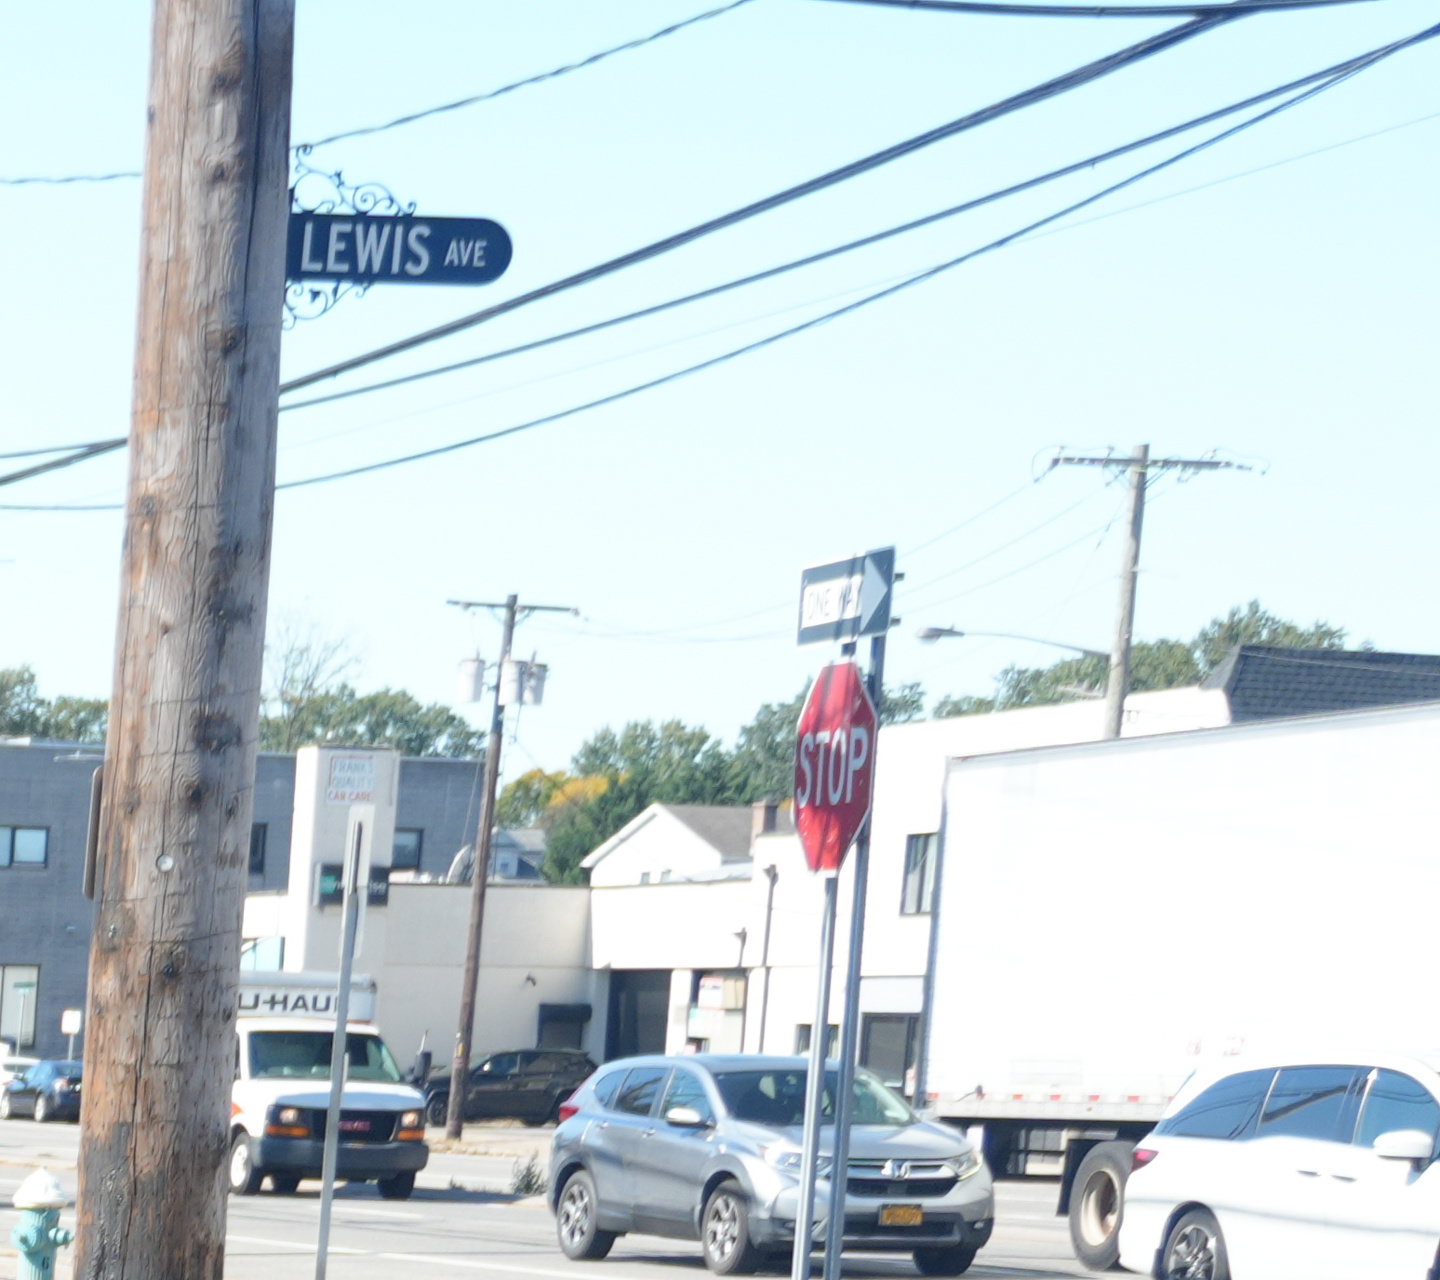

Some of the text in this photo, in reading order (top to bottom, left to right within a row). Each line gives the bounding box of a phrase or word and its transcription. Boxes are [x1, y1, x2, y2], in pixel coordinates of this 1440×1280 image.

[301, 221, 487, 276] LEWIS AVE
[797, 727, 868, 808] STOP
[42, 1256, 50, 1271] 6
